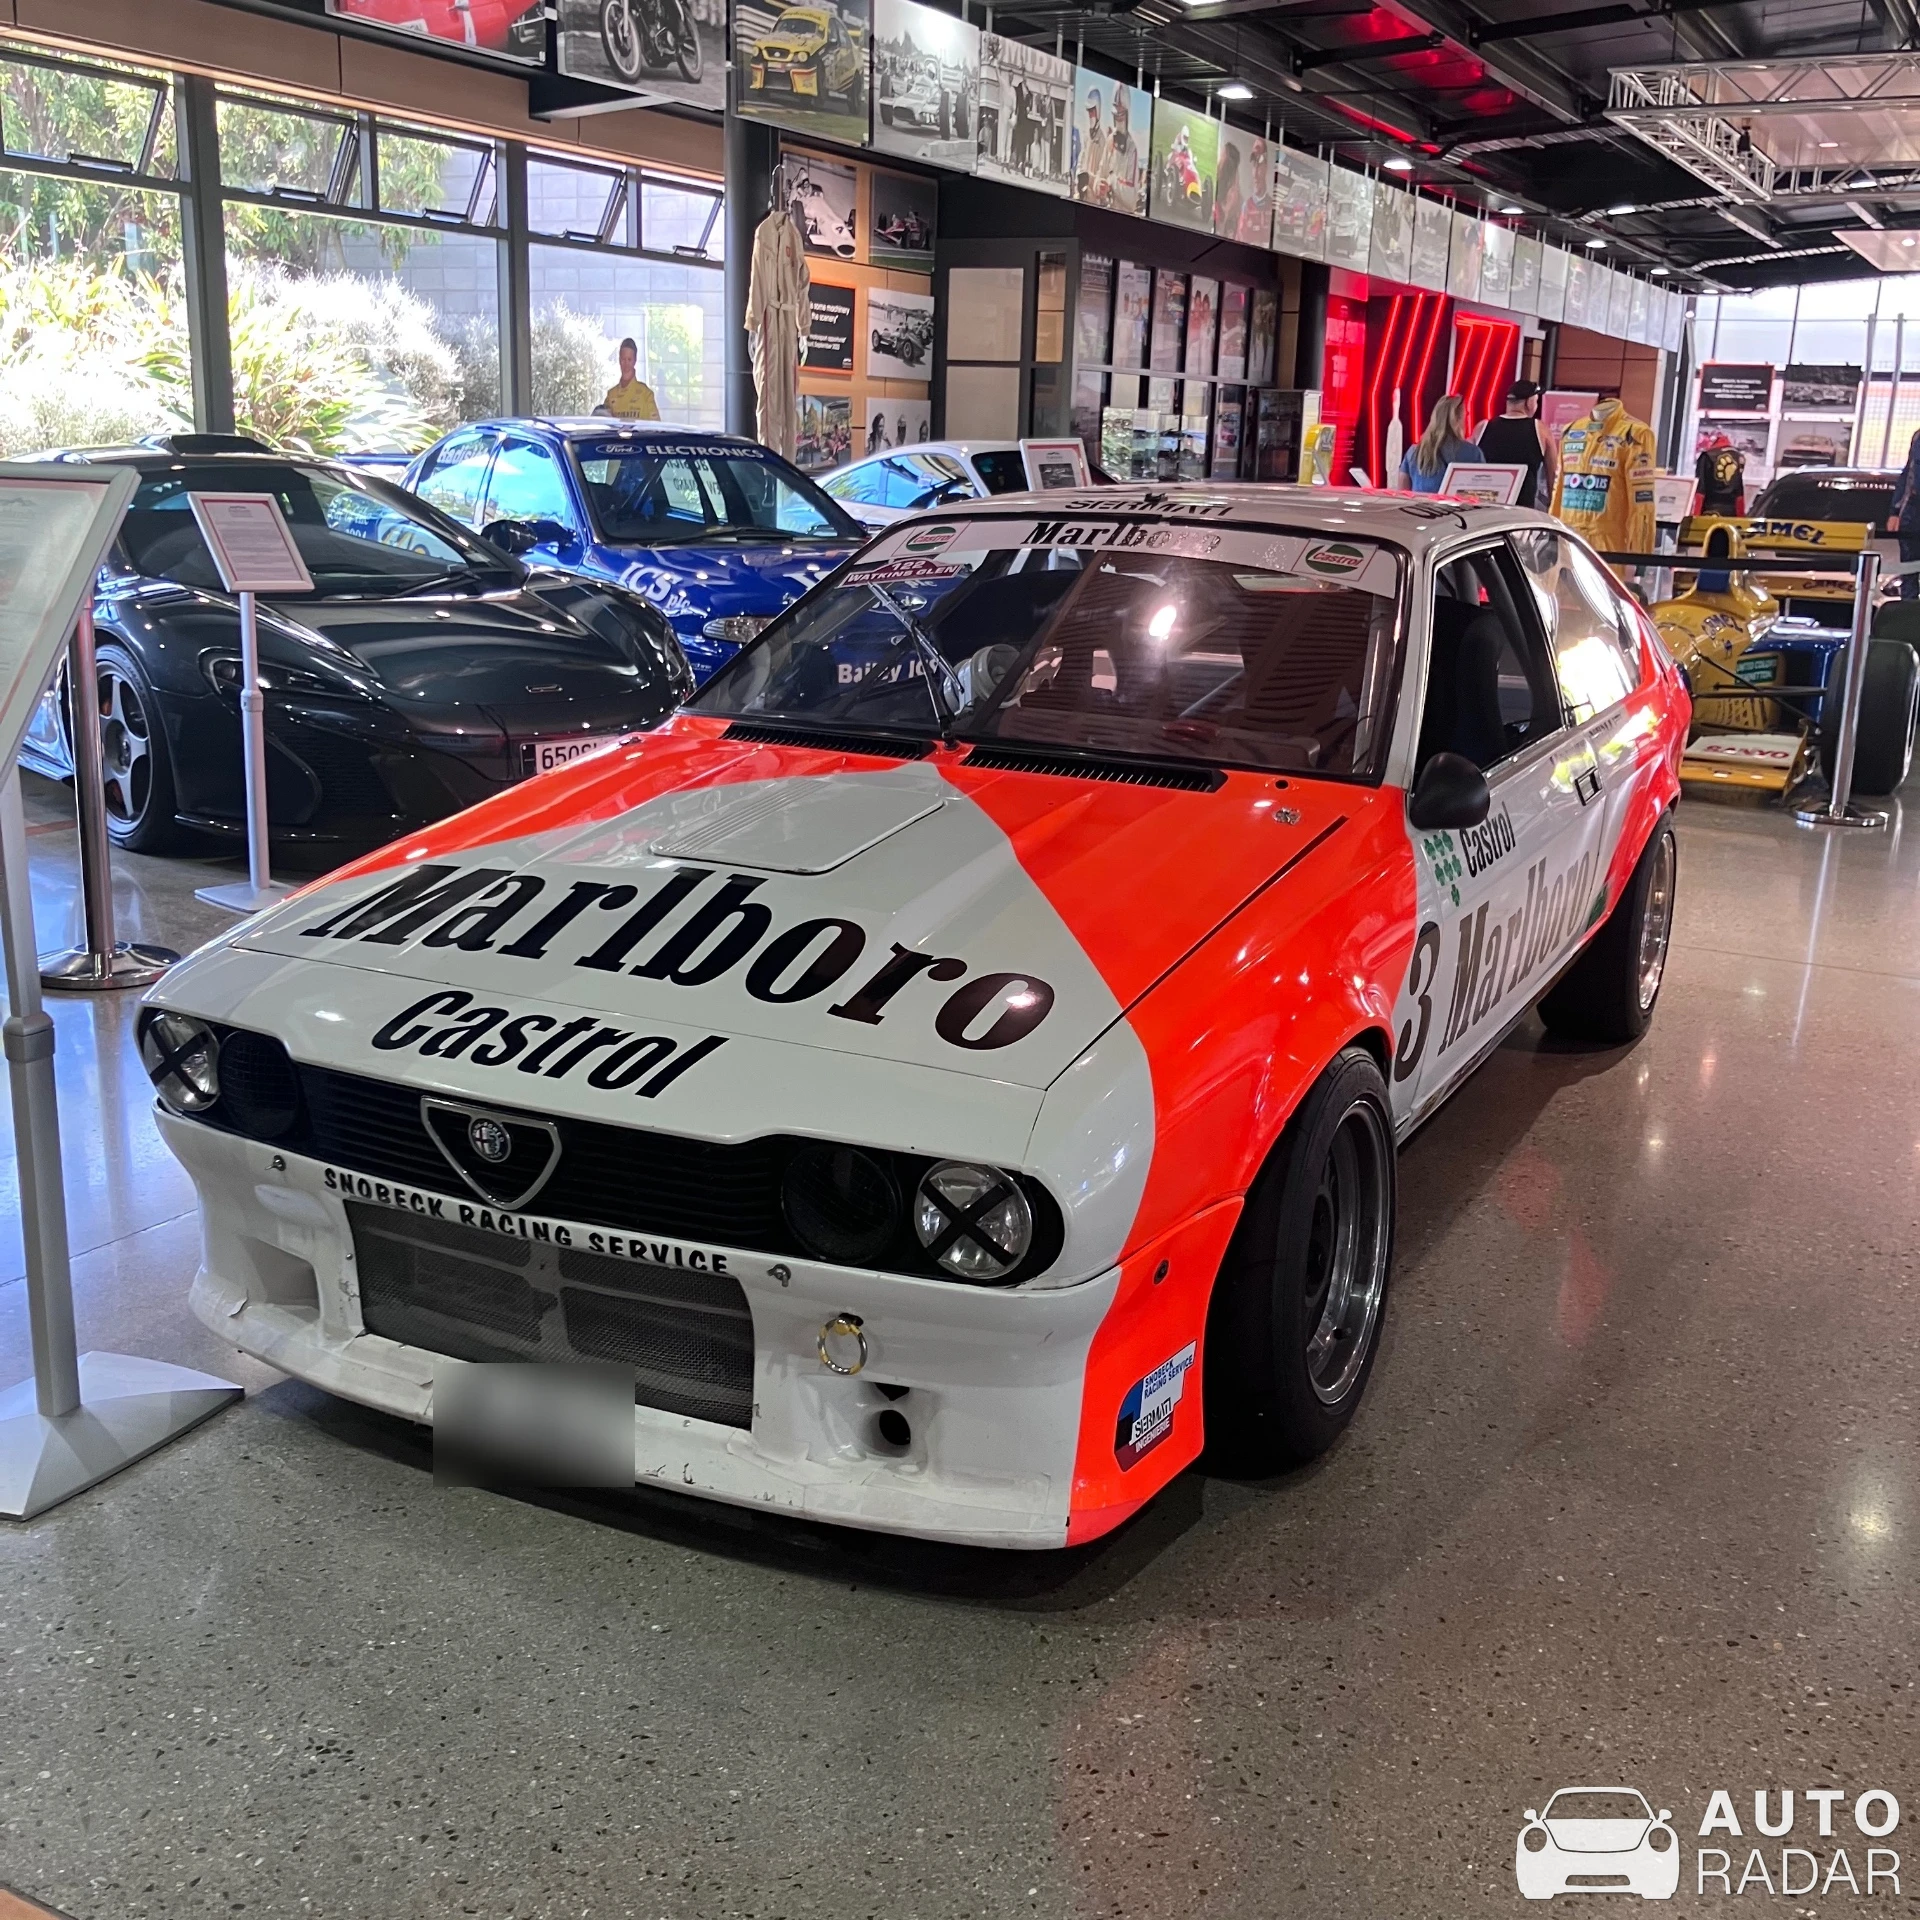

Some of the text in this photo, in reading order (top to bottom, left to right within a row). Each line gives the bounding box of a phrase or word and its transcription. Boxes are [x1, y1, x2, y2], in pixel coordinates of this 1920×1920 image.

[645, 445, 764, 459] ELECTRONICS
[912, 532, 955, 544] Castrol
[848, 564, 960, 583] WATKINS GLEN
[891, 560, 926, 571] 122
[1312, 550, 1365, 567] Castrol
[620, 561, 684, 602] ICS
[665, 593, 692, 611] plc
[838, 662, 903, 684] Baiy
[1459, 801, 1517, 878] Castrol
[299, 863, 1056, 1052] Marlboro
[1394, 850, 1591, 1083] 3 Marlboro
[370, 989, 730, 1099] Castrol
[323, 1166, 729, 1275] SNOBECK RACING SERVICE
[1144, 1354, 1193, 1400] RACING SERVICE
[1145, 1358, 1174, 1388] SNOBECK
